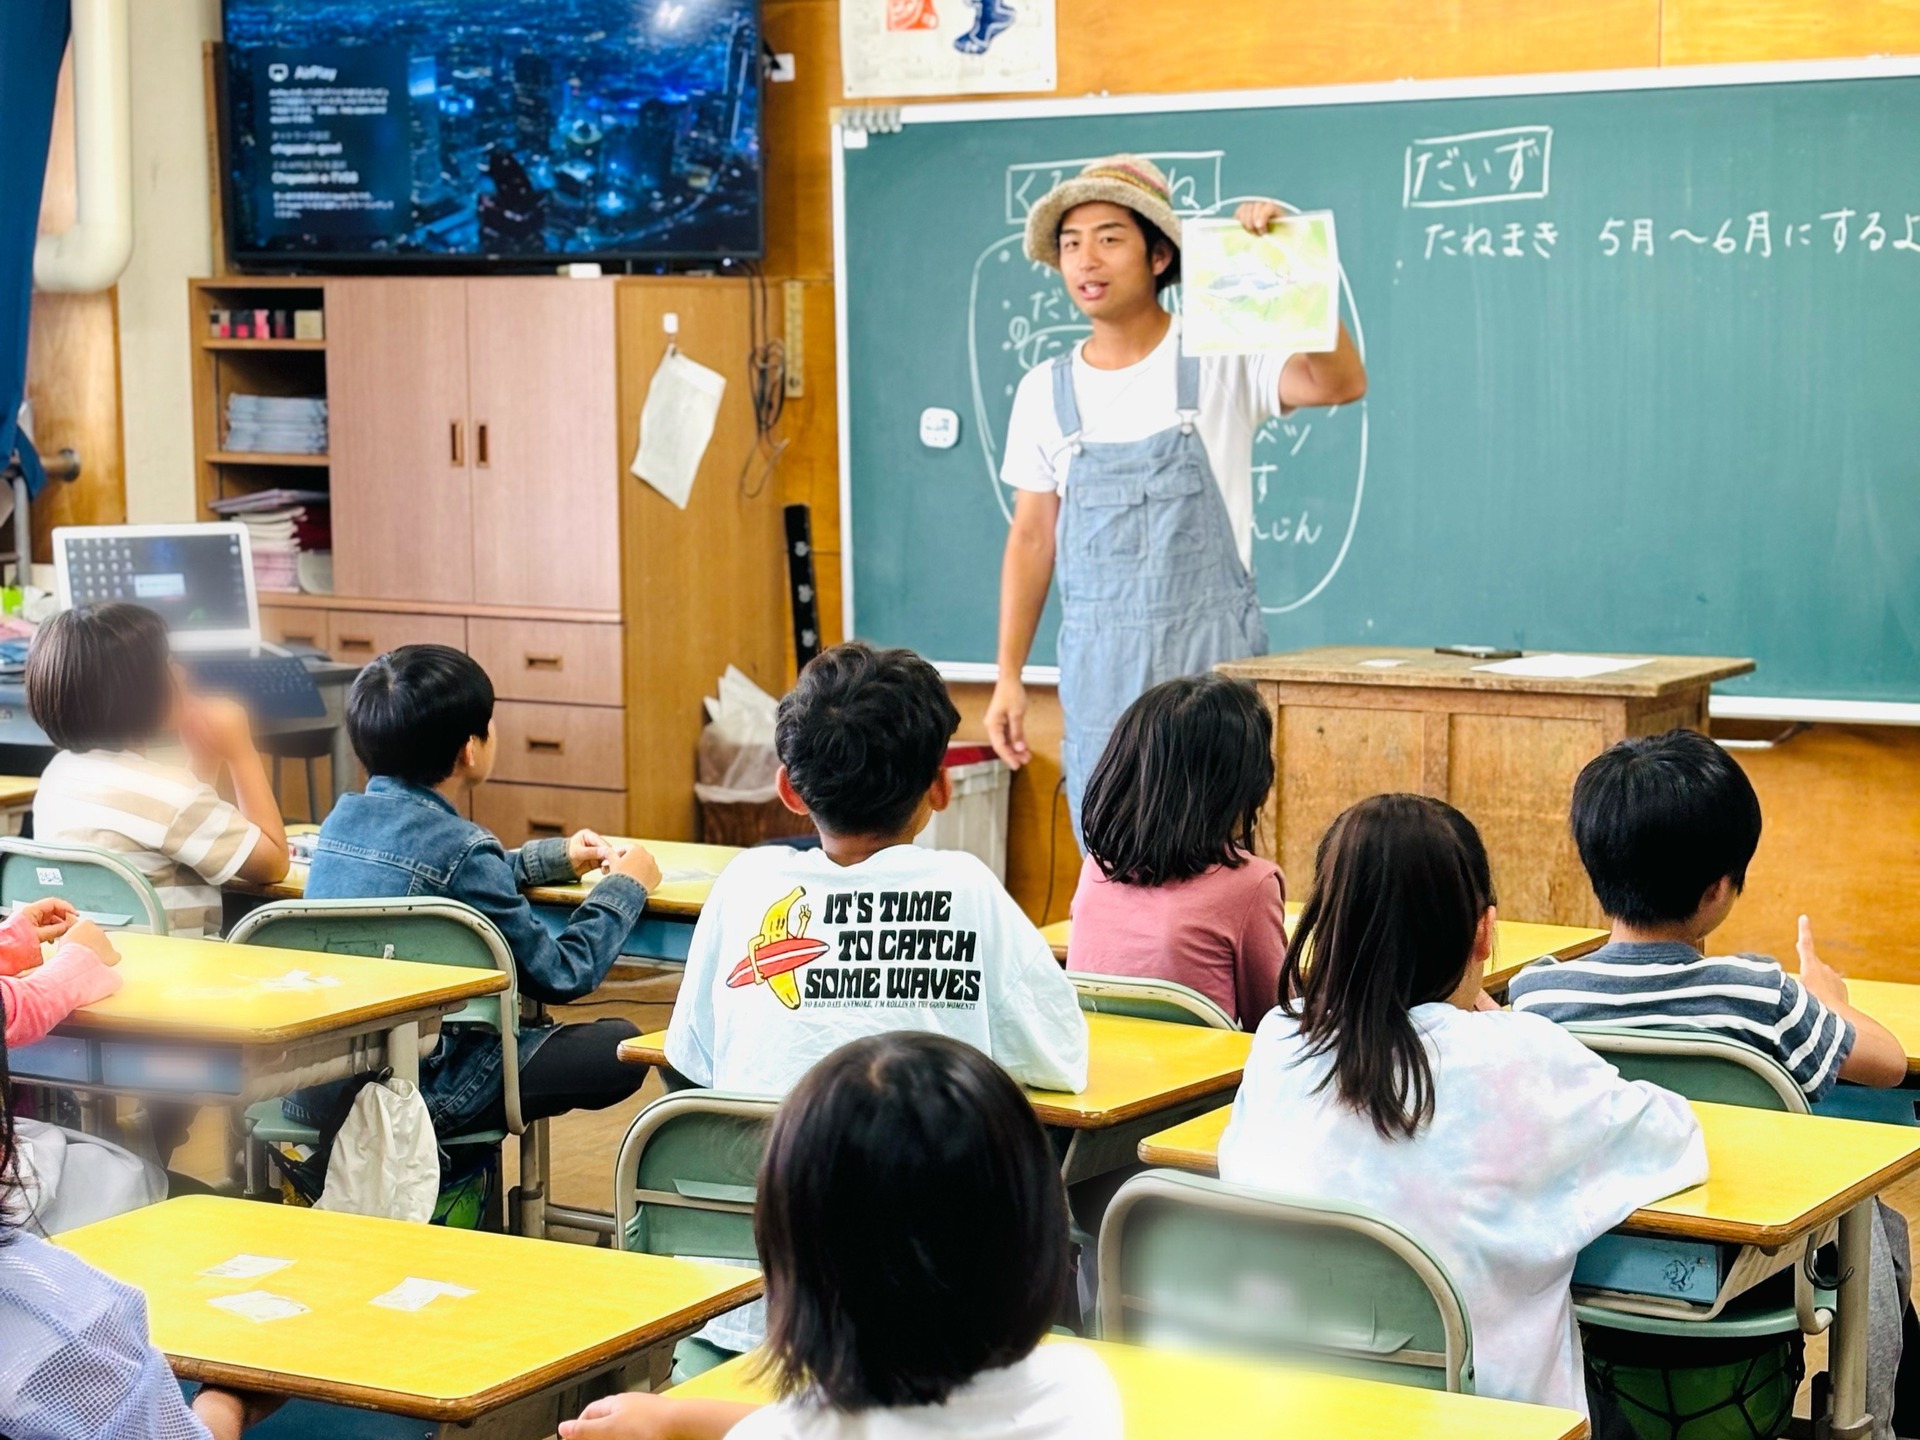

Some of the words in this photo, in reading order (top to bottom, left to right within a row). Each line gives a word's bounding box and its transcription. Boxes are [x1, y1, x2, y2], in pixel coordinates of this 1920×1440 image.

[1412, 137, 1541, 198] だいず
[1425, 222, 1559, 260] たねまき
[823, 890, 874, 924] IT'S
[879, 890, 953, 922] TIME
[838, 930, 874, 961] TO
[878, 929, 977, 962] CATCH
[804, 967, 881, 999] SOME
[886, 967, 982, 1001] WAVES
